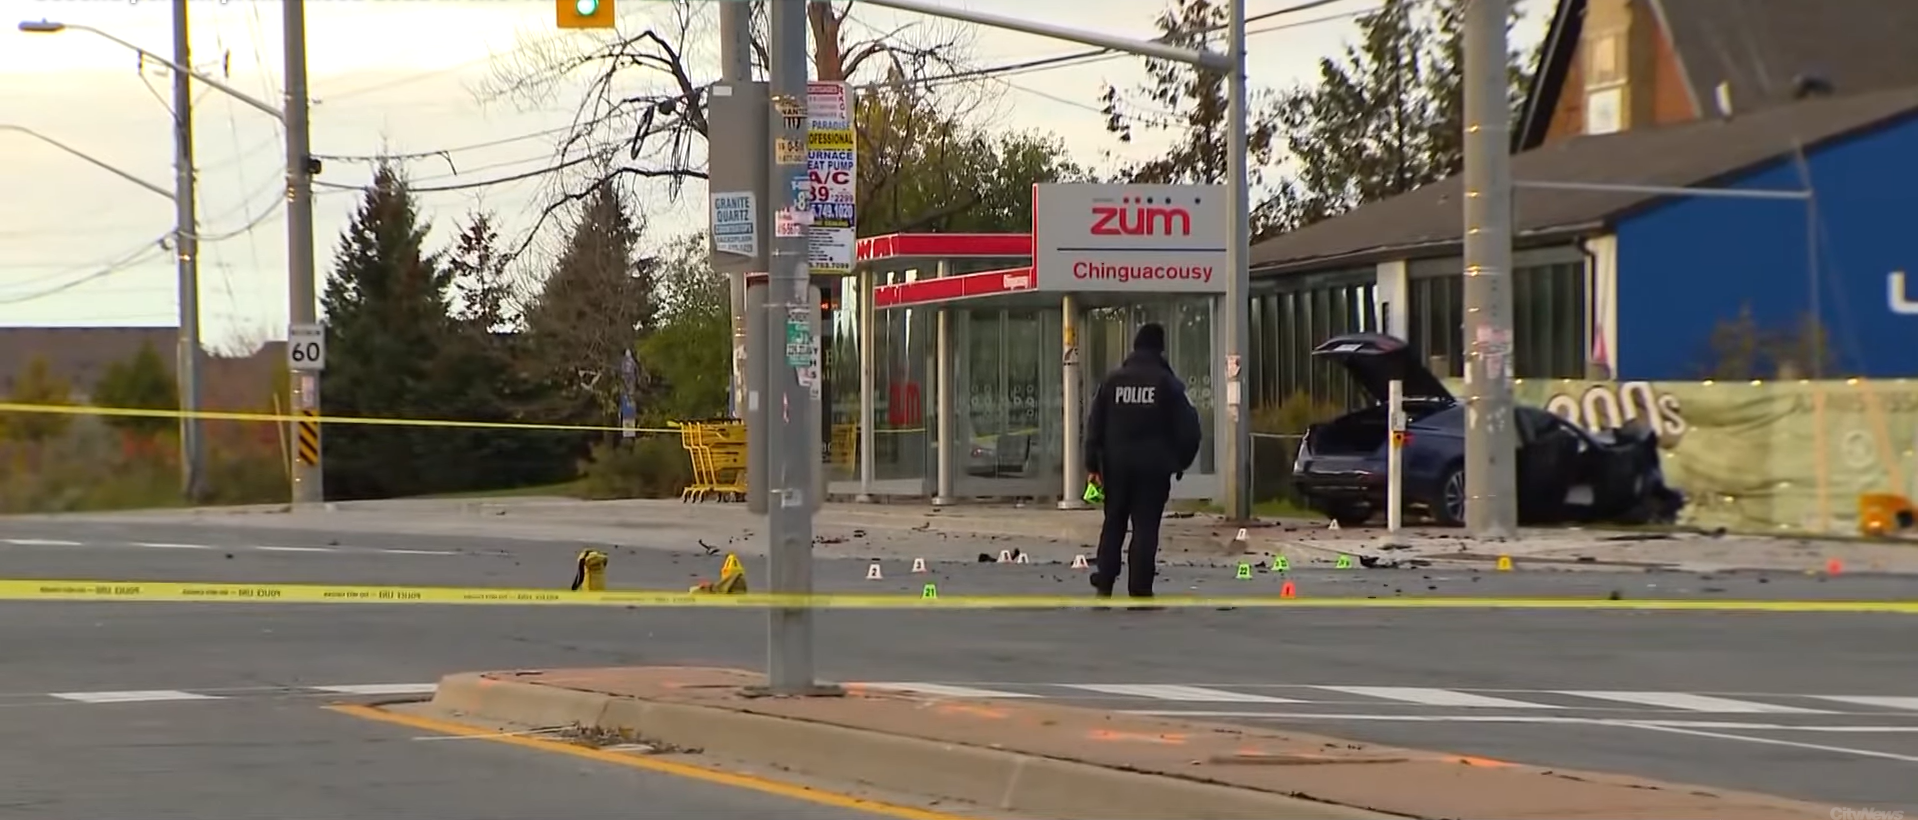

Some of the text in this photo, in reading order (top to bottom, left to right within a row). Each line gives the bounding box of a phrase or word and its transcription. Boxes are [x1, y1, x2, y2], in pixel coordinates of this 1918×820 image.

[828, 160, 853, 171] PUMP
[809, 171, 850, 185] A/C
[714, 196, 751, 210] GRANITE
[716, 209, 749, 223] QUARTZ
[1073, 262, 1213, 283] Chinguacousy
[291, 342, 320, 362] 60
[1115, 386, 1156, 404] POLICE
